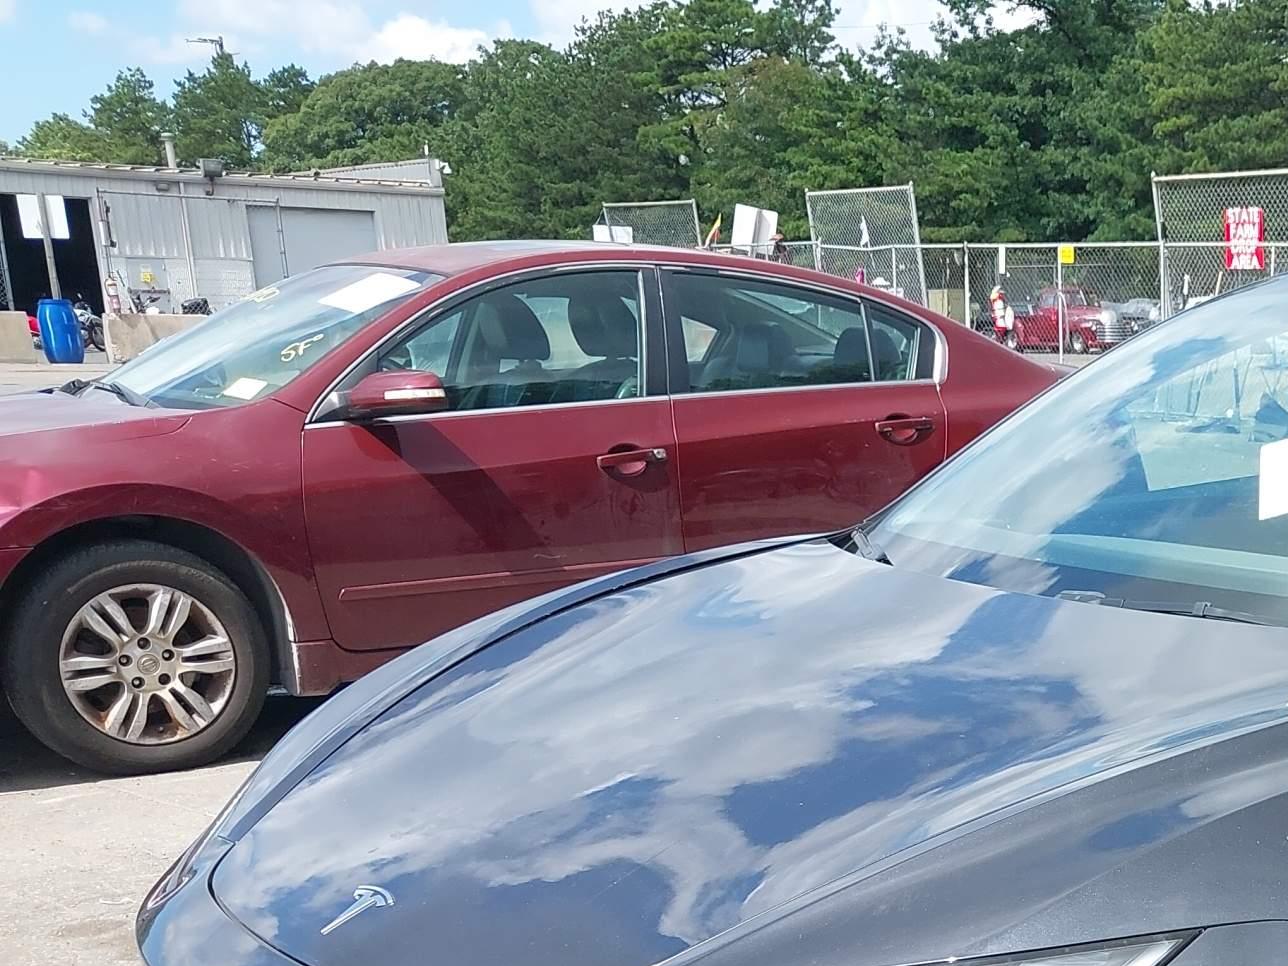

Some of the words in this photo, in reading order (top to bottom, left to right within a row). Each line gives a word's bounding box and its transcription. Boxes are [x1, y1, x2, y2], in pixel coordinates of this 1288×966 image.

[1225, 207, 1260, 223] STATE
[1229, 223, 1260, 239] FARM
[1230, 253, 1263, 269] AREA
